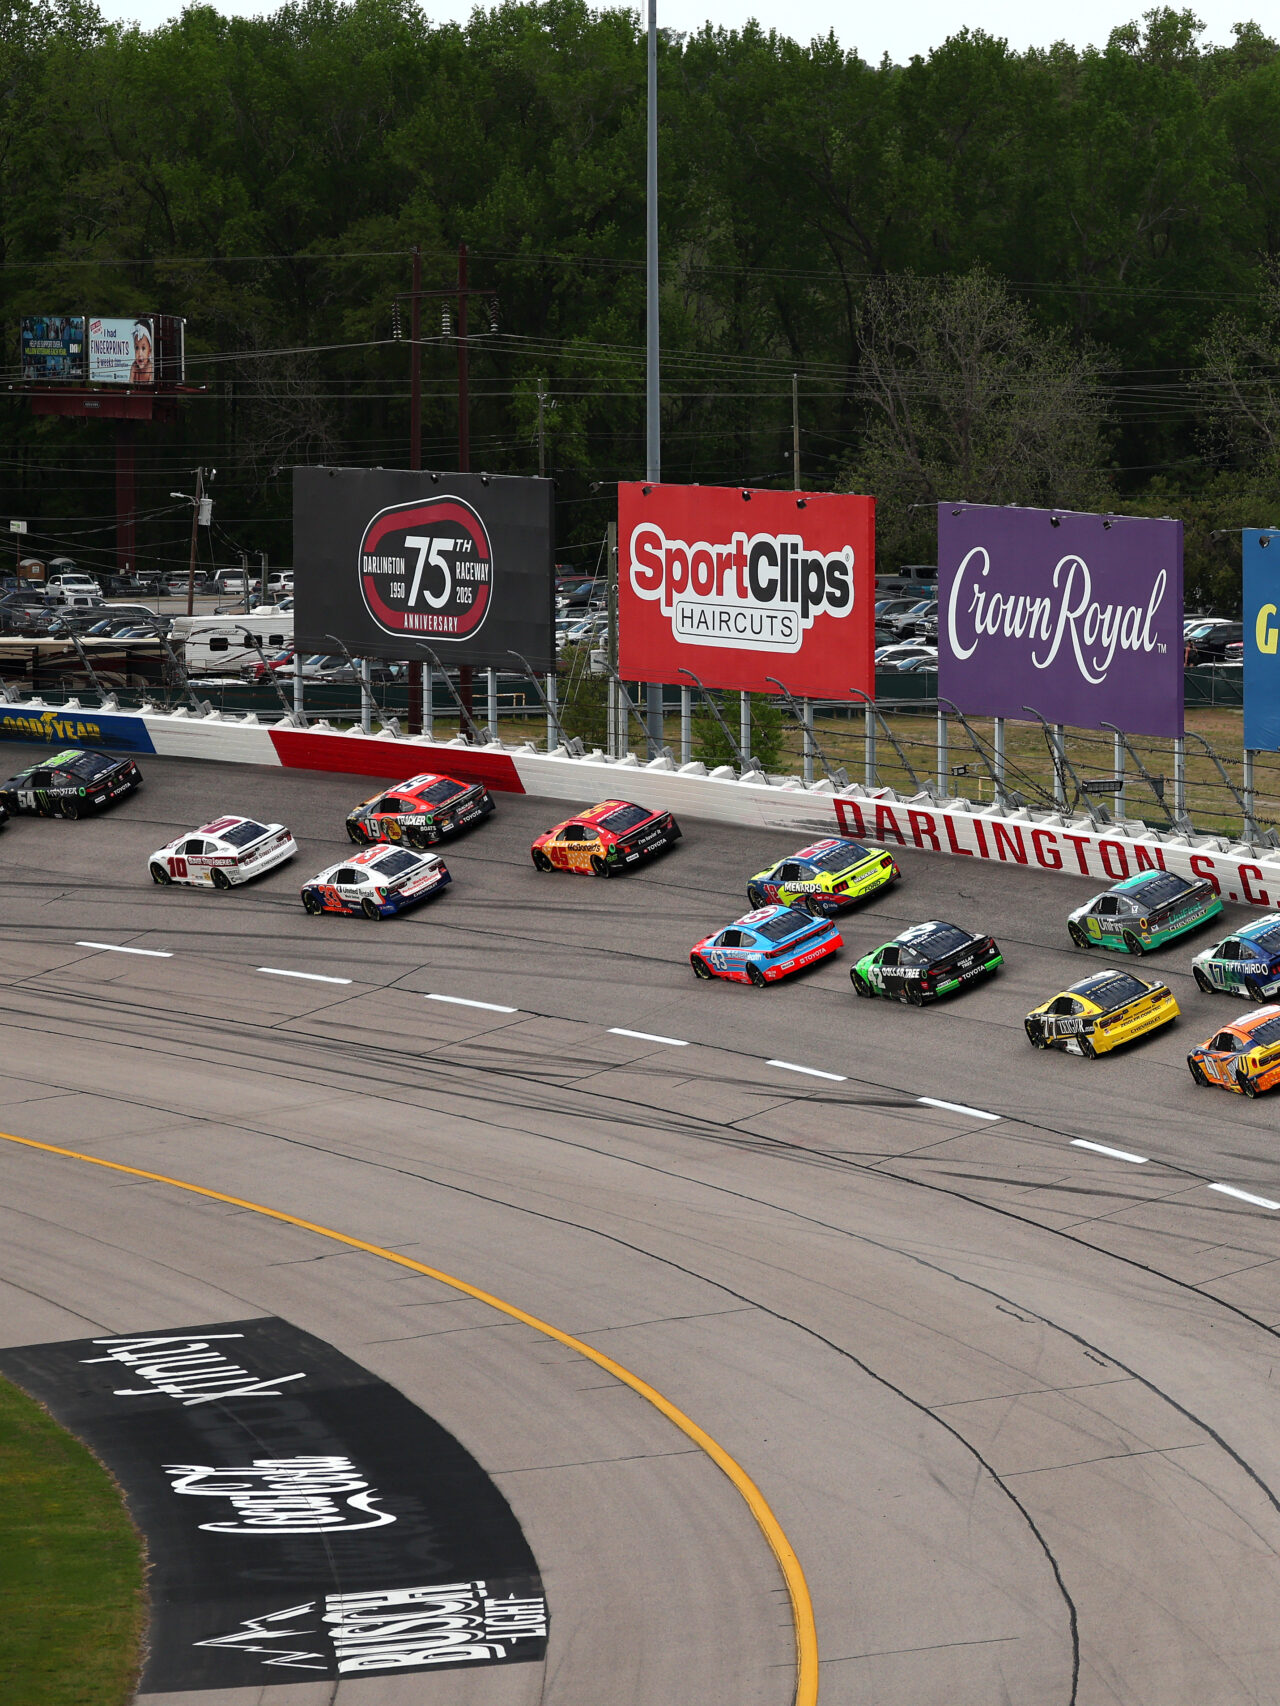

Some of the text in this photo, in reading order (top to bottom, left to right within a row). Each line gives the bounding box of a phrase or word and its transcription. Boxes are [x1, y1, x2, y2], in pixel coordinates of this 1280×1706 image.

[91, 340, 129, 356] FINGERPRINTS
[364, 556, 405, 574] DARLINGTON
[456, 562, 488, 582] RACEWAY
[390, 582, 405, 598] 1950
[456, 586, 472, 604] 2025
[404, 613, 458, 632] ANNIVERSARY
[682, 608, 793, 638] HAIRCUTS
[948, 546, 1166, 684] Crown Royal
[114, 782, 131, 795] TOYOTA
[18, 790, 36, 808] 54
[396, 816, 426, 826] TRACKER
[462, 810, 482, 824] TOYOTA
[364, 818, 380, 838] 19
[648, 838, 667, 852] TOYOTA
[833, 798, 1165, 880] DARLINGTON
[261, 852, 284, 866] CHEVROLET
[550, 846, 569, 866] 45
[167, 856, 188, 878] 10
[318, 884, 342, 908] 33
[342, 886, 358, 895] United
[413, 882, 438, 898] CHEVROLET
[764, 884, 784, 904] 12
[784, 882, 822, 893] MENARDS
[1168, 902, 1202, 925] UniFirst
[1168, 909, 1207, 932] CHEVROLET
[1086, 917, 1102, 940] 9
[710, 950, 728, 970] 43
[804, 948, 826, 962] TOYOTA
[957, 956, 974, 967] DOLLAR
[882, 968, 920, 978] DOLLAR TREE
[961, 961, 973, 969] TREE
[962, 965, 985, 980] TOYOTA
[1208, 962, 1225, 986] 17
[868, 968, 886, 990] 42
[1040, 1016, 1057, 1040] 77
[1130, 1016, 1161, 1034] CHEVROLET
[1203, 1055, 1220, 1080] 47
[322, 1580, 506, 1674] BUSCH
[484, 1596, 546, 1640] LIGHT
